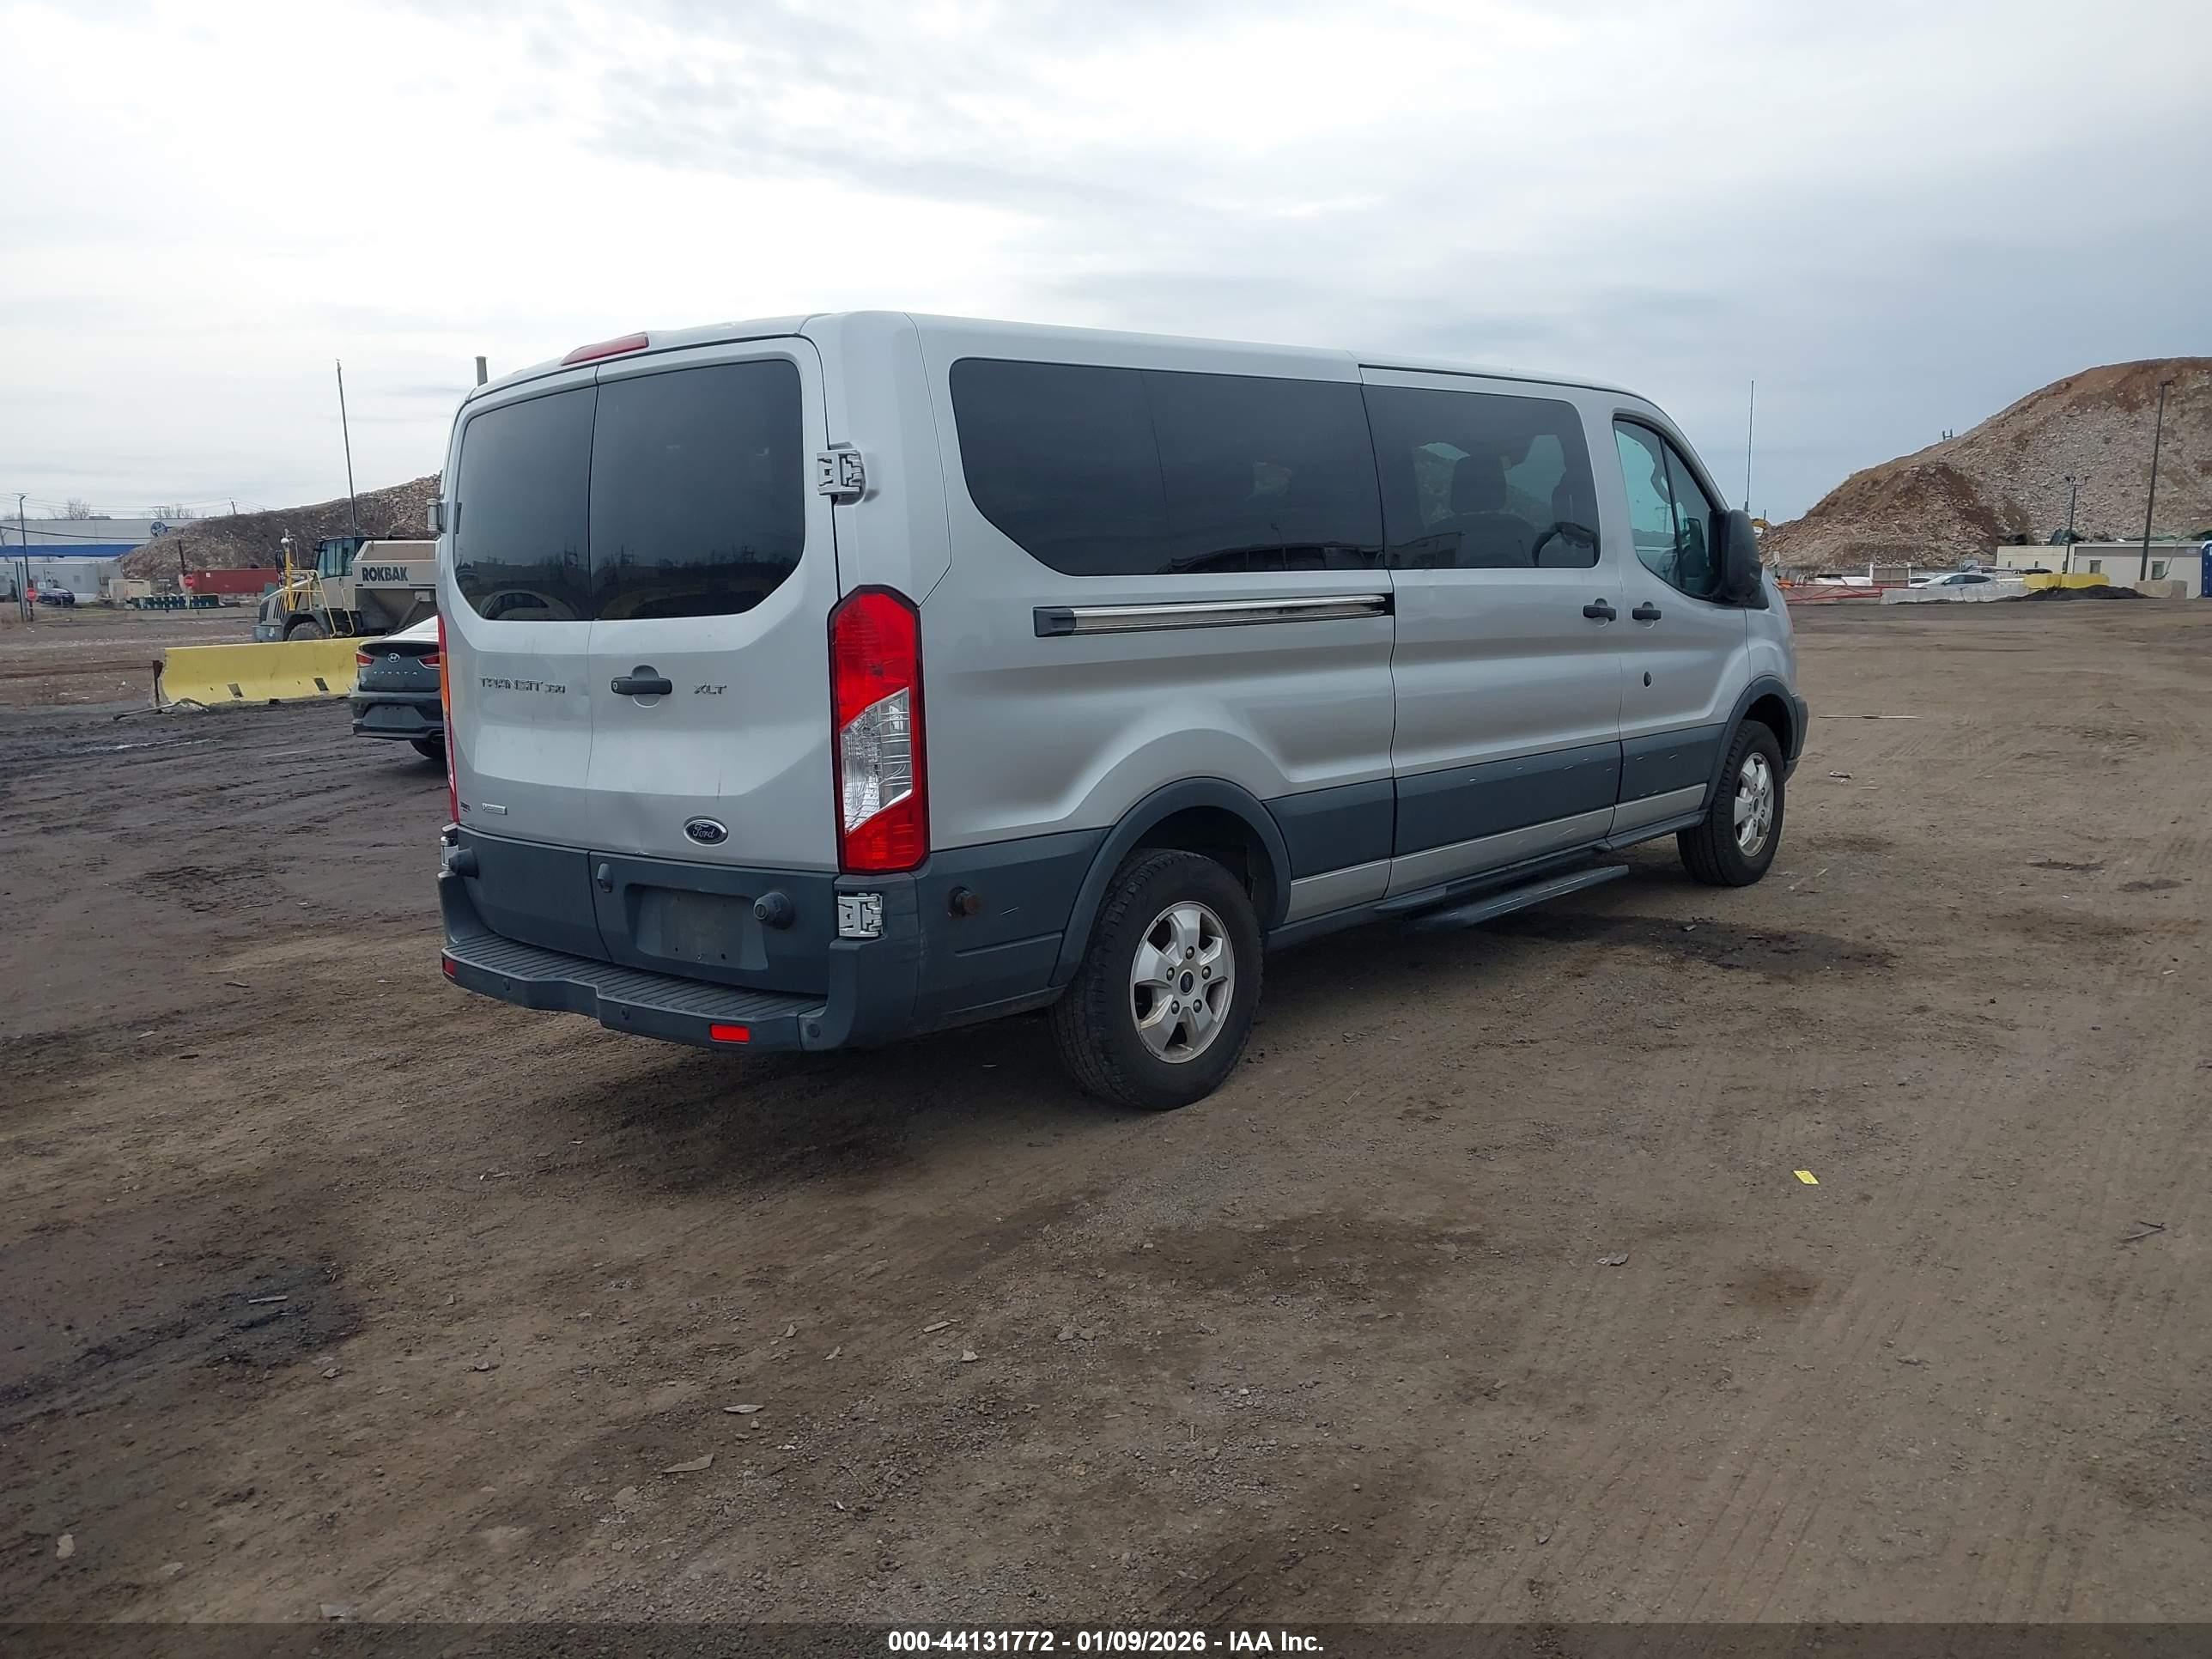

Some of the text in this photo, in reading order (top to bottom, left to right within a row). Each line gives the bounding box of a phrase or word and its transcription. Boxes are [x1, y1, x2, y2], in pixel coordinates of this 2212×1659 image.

[362, 567, 409, 581] ROKBAK
[693, 684, 727, 695] XLT
[692, 823, 715, 838] Ford
